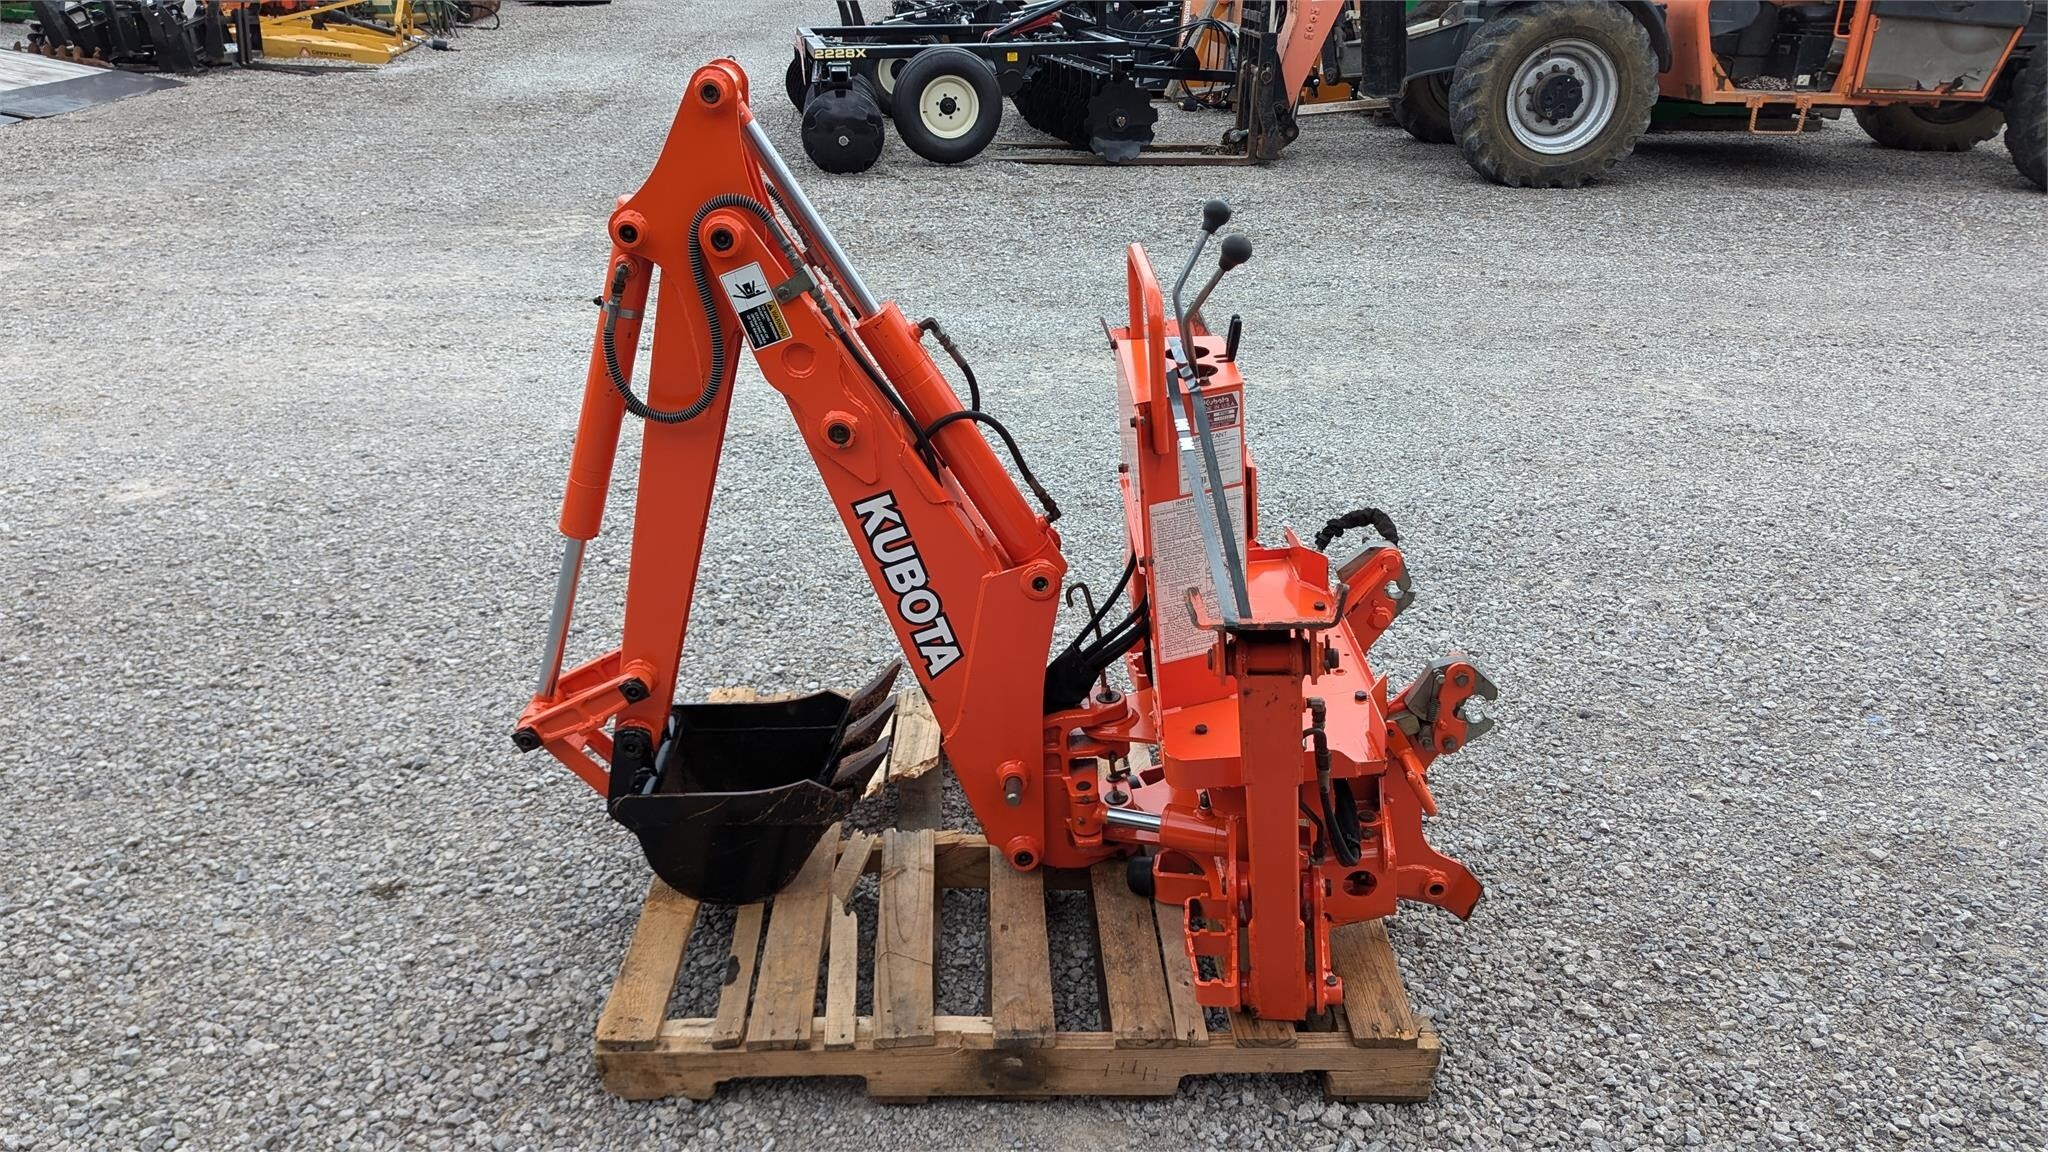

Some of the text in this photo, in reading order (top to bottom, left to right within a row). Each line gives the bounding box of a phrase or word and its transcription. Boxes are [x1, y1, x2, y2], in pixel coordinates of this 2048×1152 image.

[814, 48, 867, 59] 2228X
[771, 309, 787, 336] WARNING
[851, 490, 964, 680] KUBOTA
